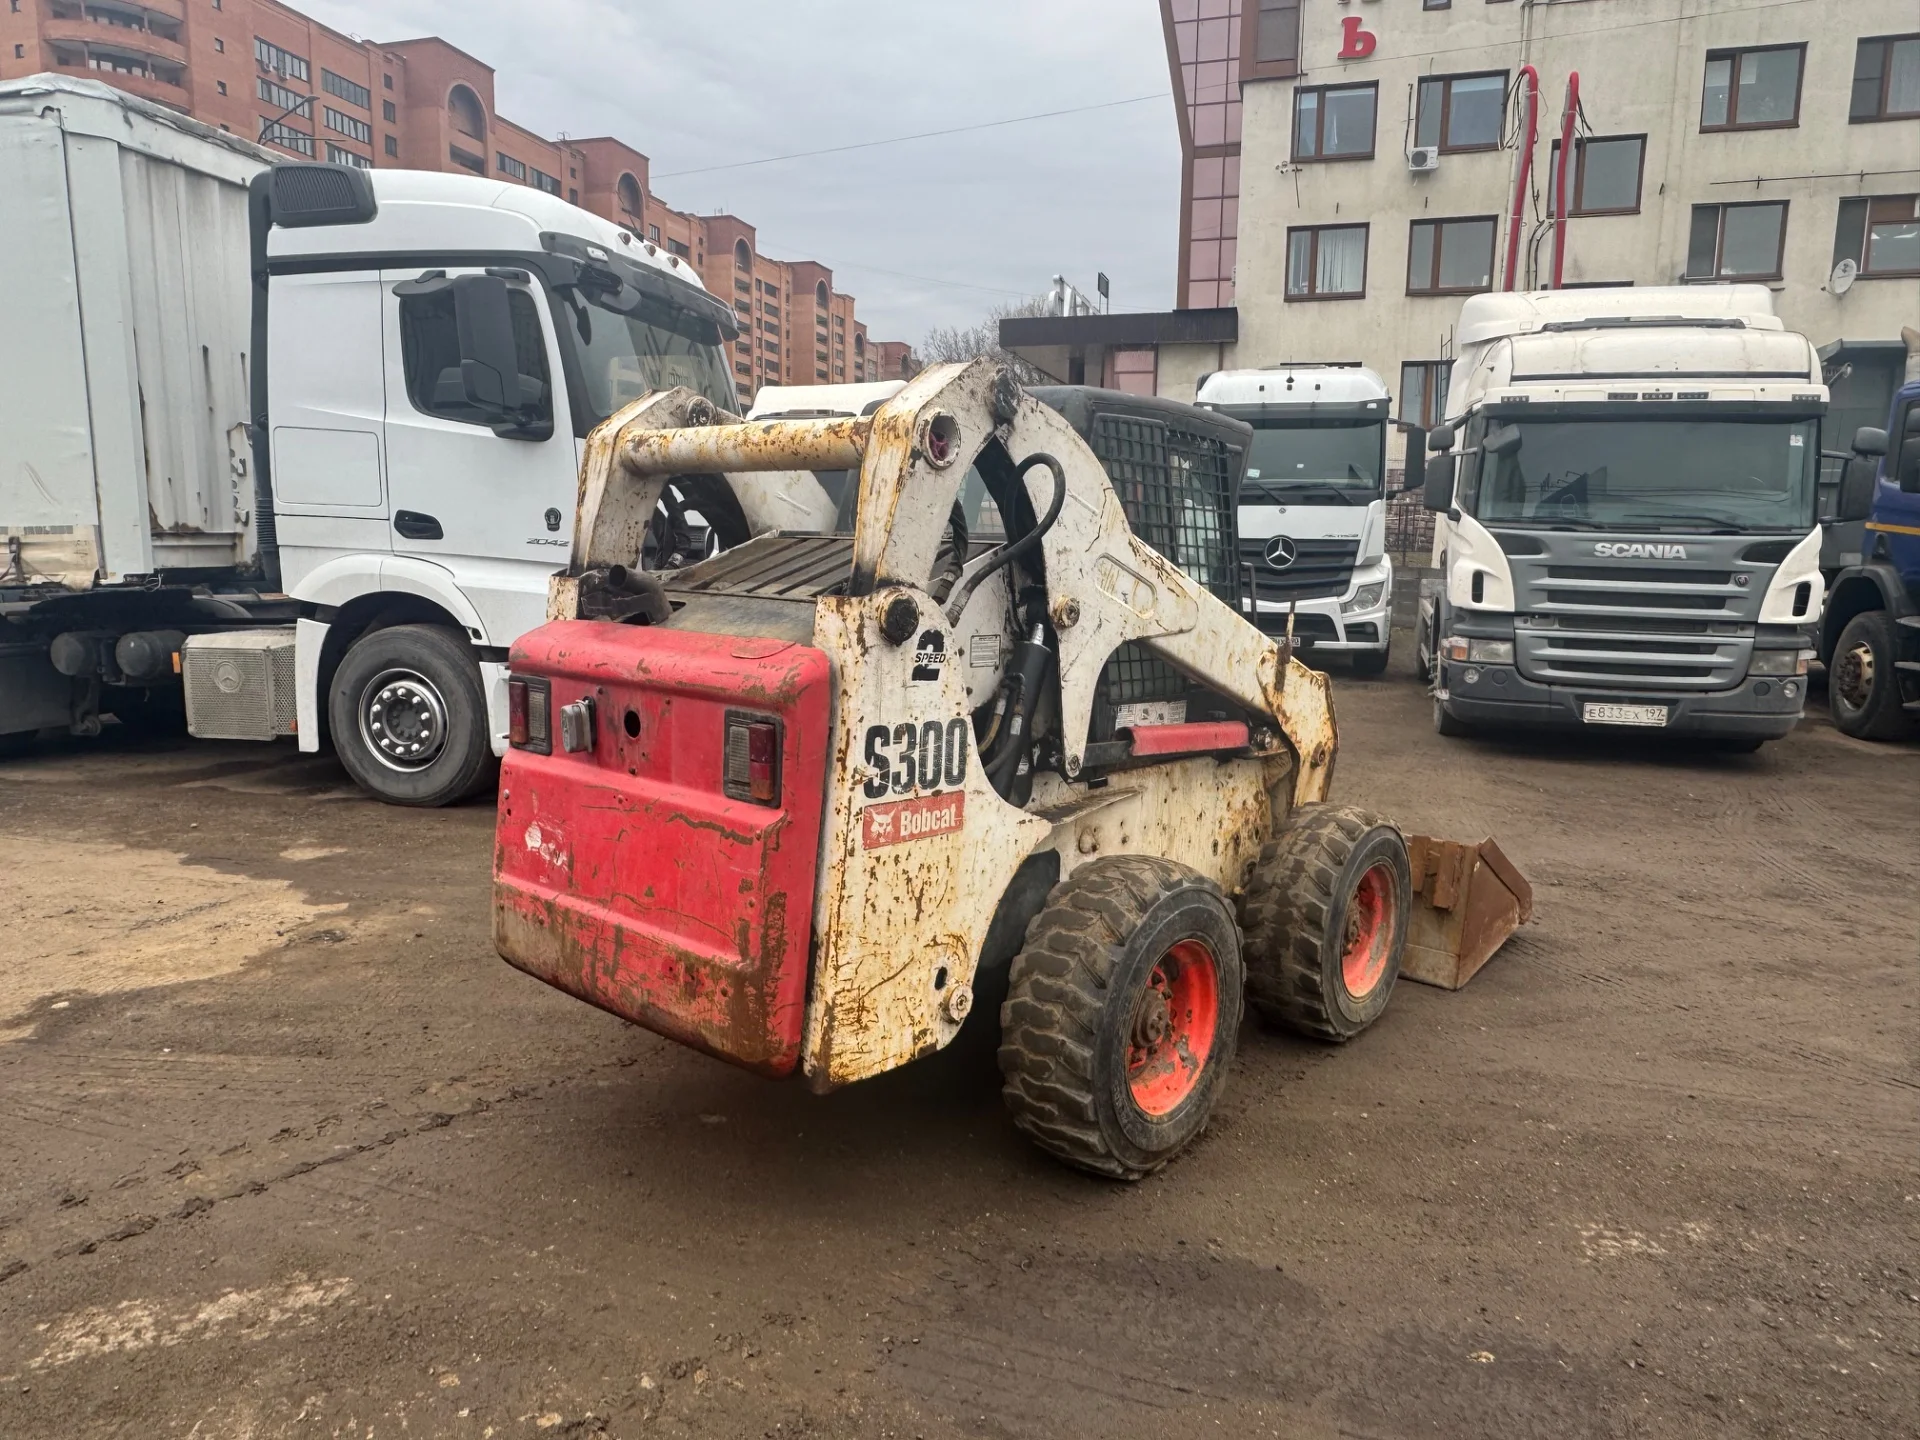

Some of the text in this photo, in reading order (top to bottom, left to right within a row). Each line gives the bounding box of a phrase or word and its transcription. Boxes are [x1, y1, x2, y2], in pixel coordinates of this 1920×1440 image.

[1593, 542, 1687, 559] SCANIA
[911, 629, 945, 681] 2
[915, 652, 946, 663] SPEED
[863, 717, 968, 799] S300
[900, 803, 957, 837] Bobcat
